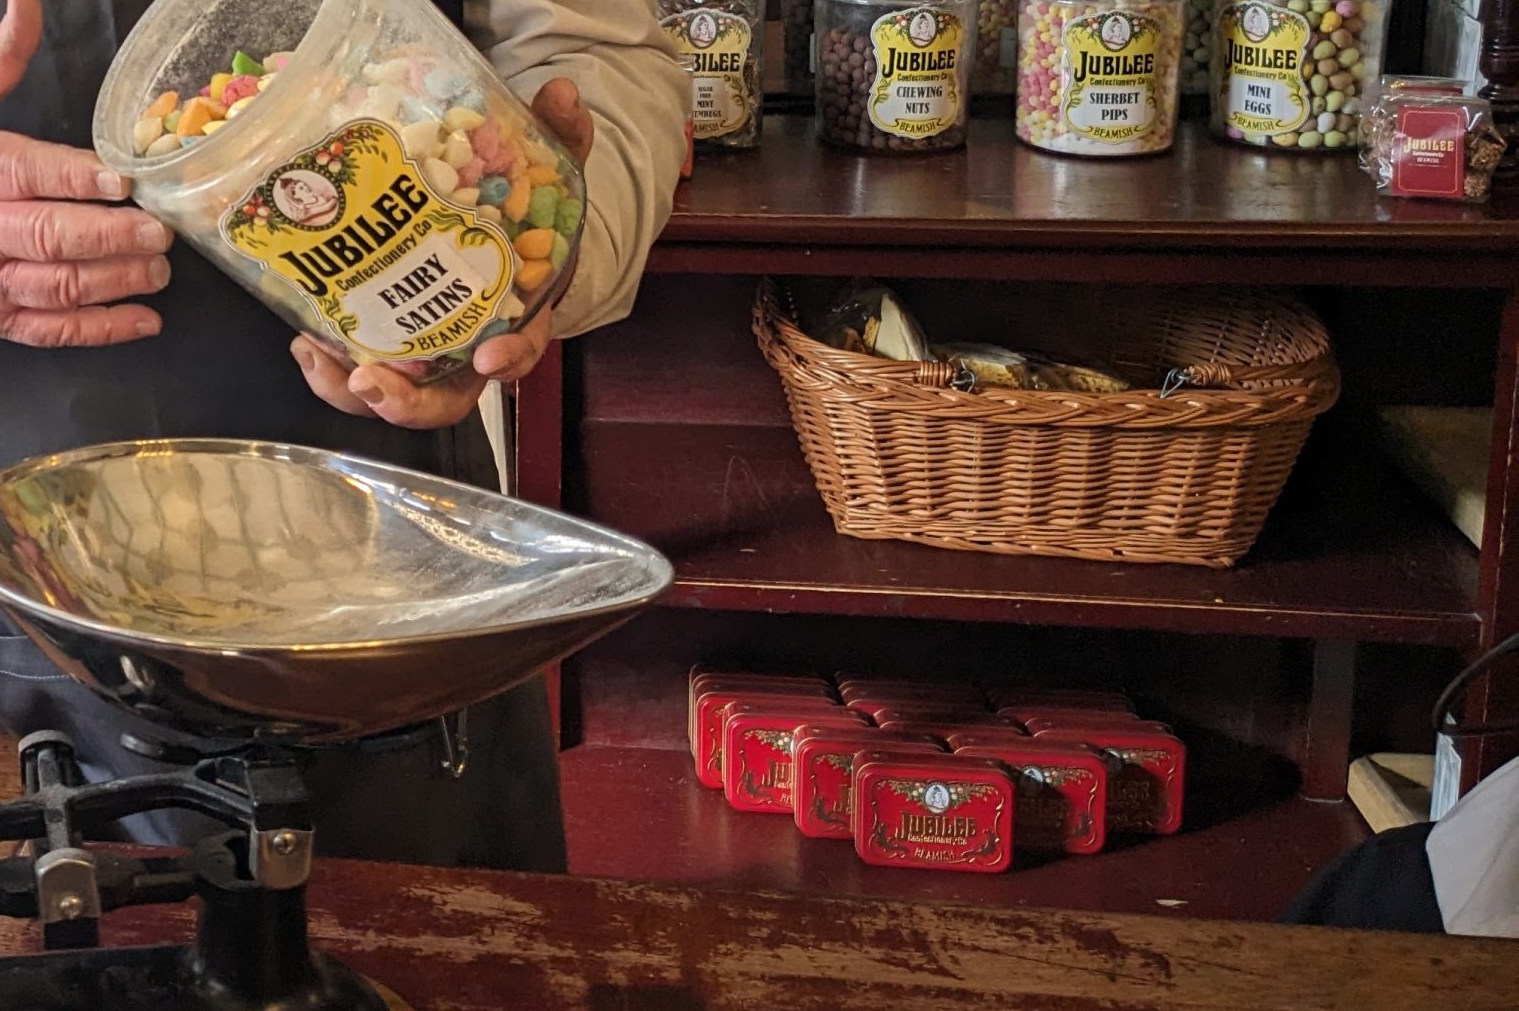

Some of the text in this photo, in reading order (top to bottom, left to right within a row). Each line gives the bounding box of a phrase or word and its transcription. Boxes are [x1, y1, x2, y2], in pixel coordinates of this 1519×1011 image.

[1224, 39, 1297, 69] JUBILEE
[692, 53, 740, 72] BILEE
[882, 48, 955, 79] JUBILEE
[1074, 51, 1154, 82] JUBILEE
[1234, 67, 1276, 78] Confectionery
[1090, 77, 1136, 86] Confectionery
[896, 85, 943, 98] CHEWING
[1247, 83, 1271, 98] MINI
[1089, 91, 1139, 106] SHERBET
[905, 102, 930, 114] NUTS
[1101, 108, 1128, 121] PIPS
[1244, 101, 1272, 116] EGGS
[899, 121, 935, 133] BEAMISH
[1238, 117, 1275, 132] BEAMISH
[1093, 126, 1133, 139] BEAMISH
[1403, 137, 1454, 153] JUBILEE
[279, 174, 429, 298] JUBILEE
[335, 218, 433, 293] Confectionery Co
[378, 253, 450, 310] FAIRY
[395, 278, 473, 334] SATINS
[420, 302, 487, 351] BEAMISH
[895, 811, 976, 838] JUBILEE
